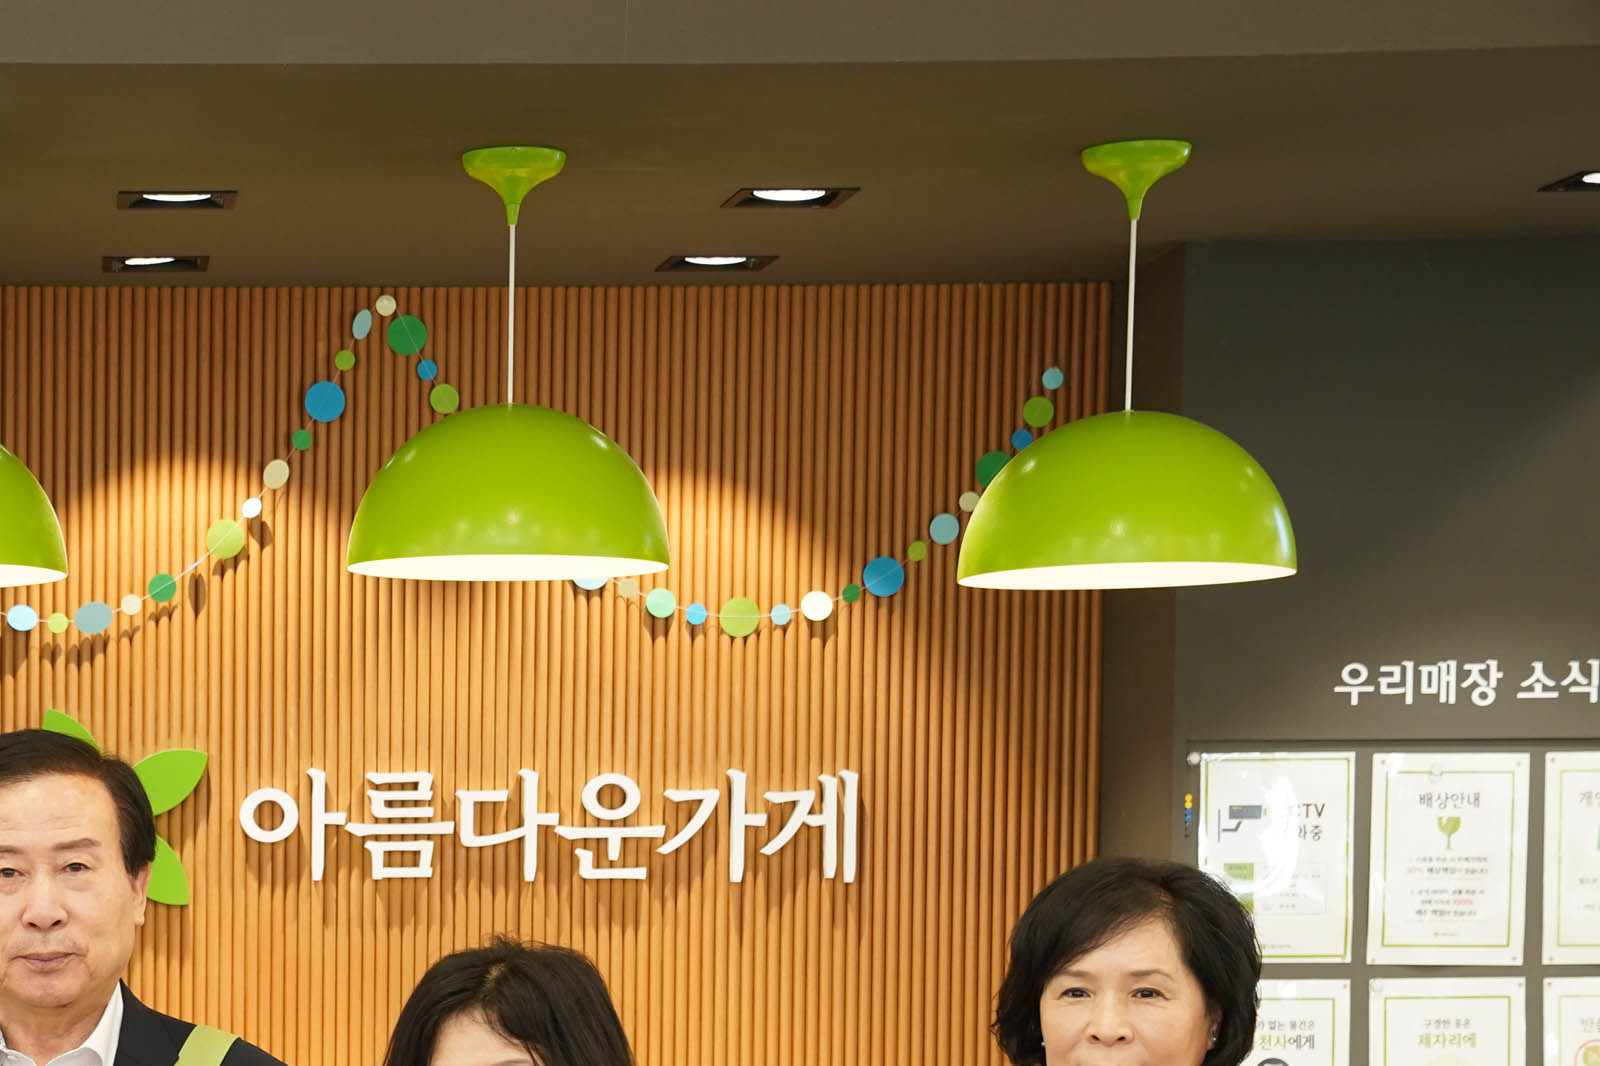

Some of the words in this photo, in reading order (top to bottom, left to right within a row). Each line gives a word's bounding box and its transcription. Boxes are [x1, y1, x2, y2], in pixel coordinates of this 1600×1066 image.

[1334, 660, 1504, 707] 우리매장
[1516, 659, 1600, 704] 소식
[1419, 792, 1481, 809] 배상안내
[239, 768, 859, 882] 아름다운가게
[1259, 1034, 1316, 1051] 천사에게
[1418, 1032, 1477, 1049] 제자리에
